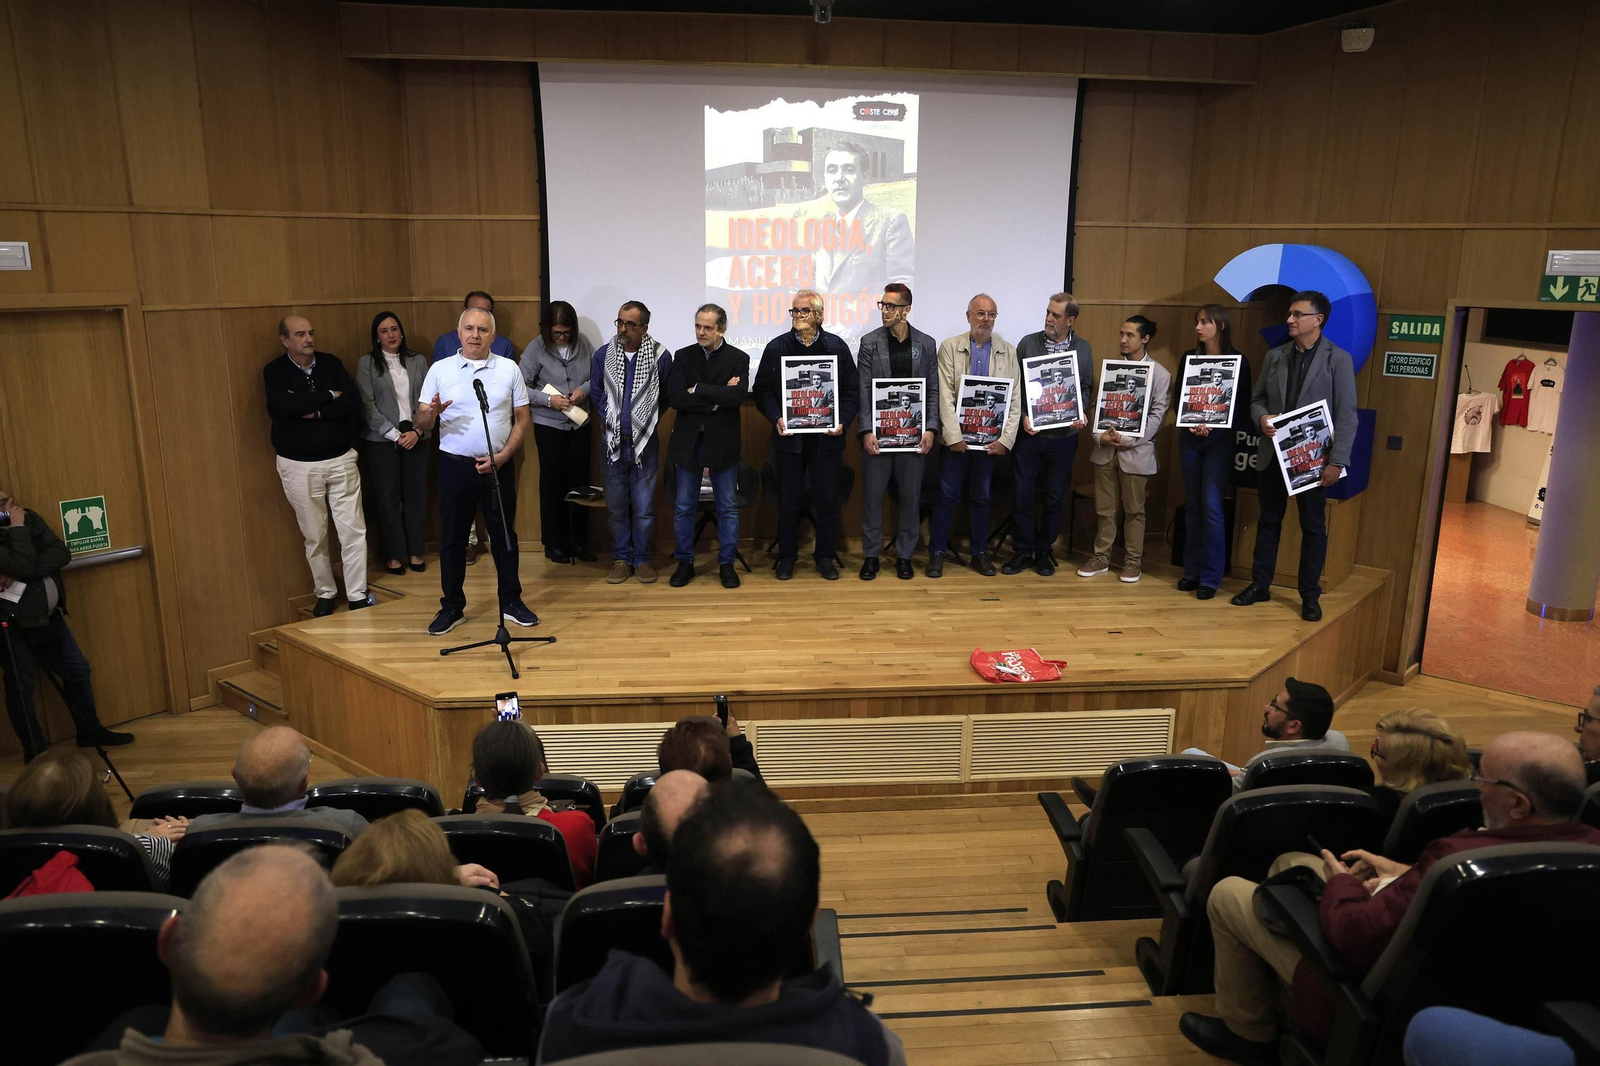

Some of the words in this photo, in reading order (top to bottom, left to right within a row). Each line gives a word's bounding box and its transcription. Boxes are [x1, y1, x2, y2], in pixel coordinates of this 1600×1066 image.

[728, 211, 873, 256] IDEOLOGÍA,
[728, 255, 813, 289] ACERO
[727, 292, 743, 326] Y
[1391, 321, 1440, 336] SALIDA
[1389, 355, 1408, 365] AFORO
[1409, 356, 1431, 366] EDIFICIO
[1390, 364, 1399, 373] 215
[1400, 365, 1428, 375] PERSONAS
